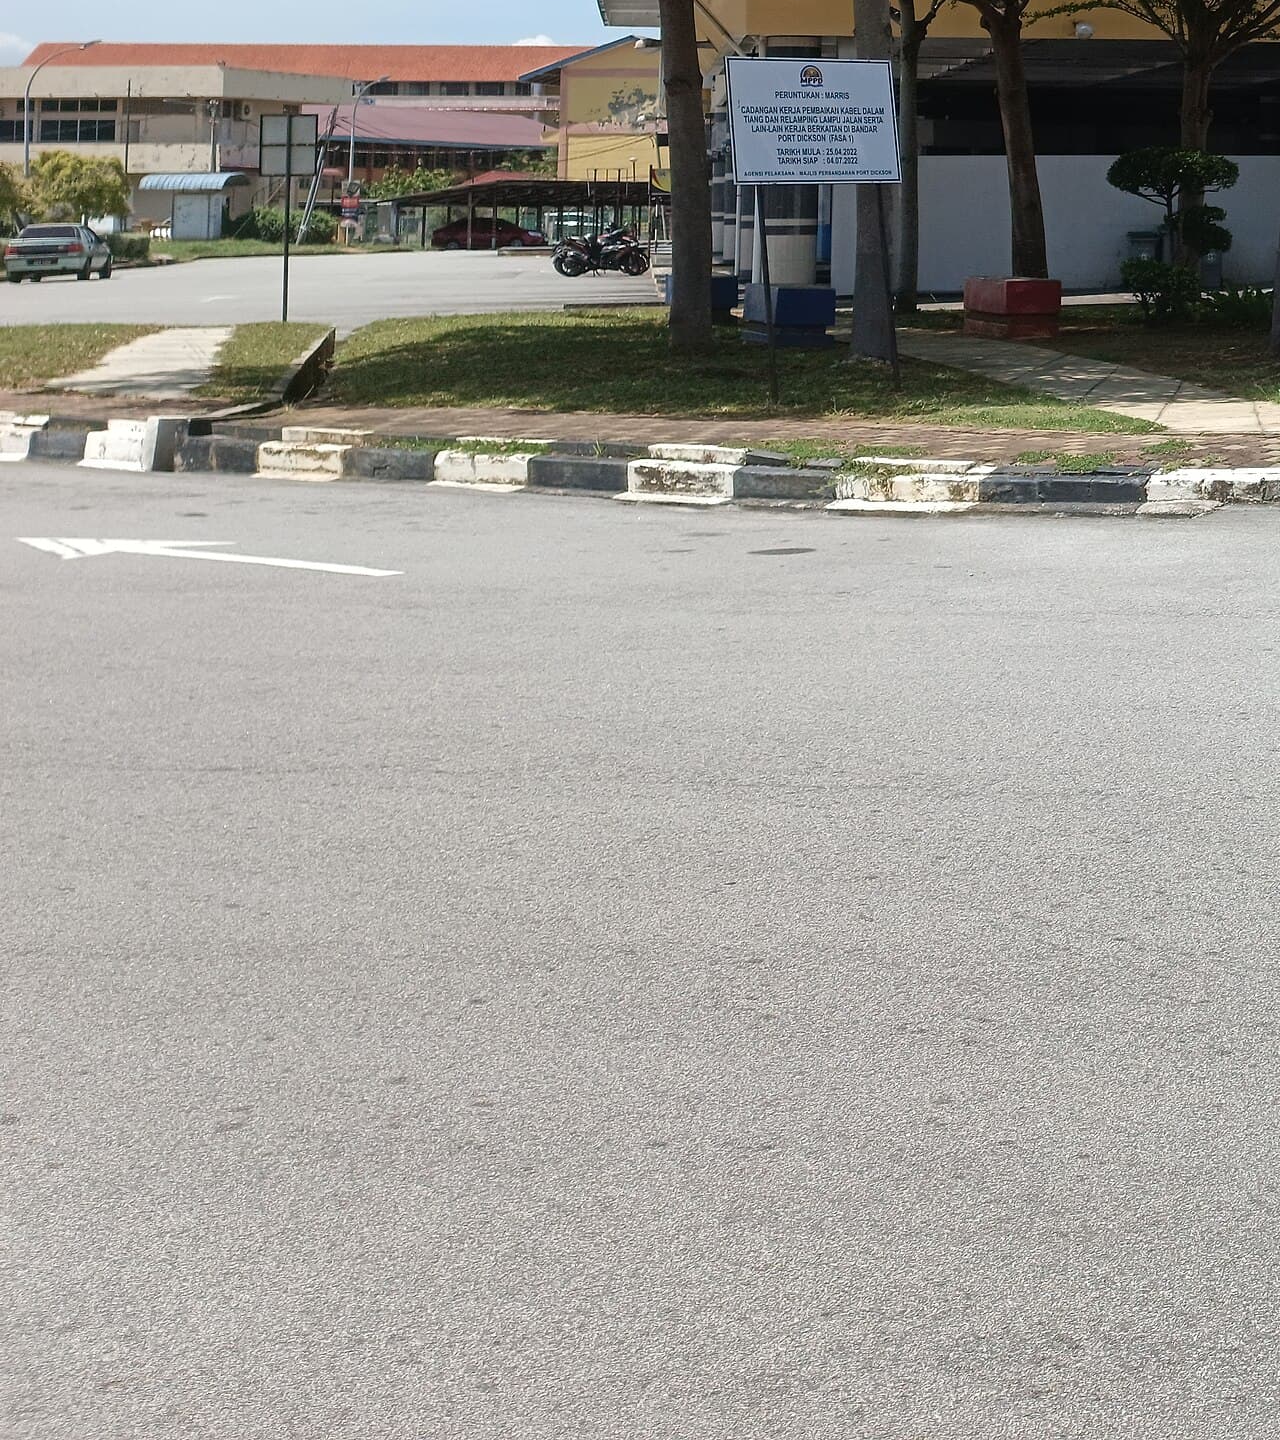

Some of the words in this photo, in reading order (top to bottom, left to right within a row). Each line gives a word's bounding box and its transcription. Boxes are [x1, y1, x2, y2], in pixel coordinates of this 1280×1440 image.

[775, 91, 820, 99] PERUNTUKAN
[824, 92, 850, 100] MARRIS
[741, 106, 778, 114] CADANGAN
[802, 107, 839, 115] PEMBAIKAN
[744, 115, 764, 123] TIANG
[780, 116, 818, 124] RELAMPING
[819, 116, 841, 124] LAMPU
[842, 116, 863, 124] JALAN
[751, 125, 783, 133] LAIN-LAIN
[784, 125, 806, 133] KERJA
[807, 125, 843, 133] BERKAITAN
[778, 134, 796, 142] PORT
[797, 134, 826, 142] DICKSON
[828, 134, 847, 143] (FASA
[776, 148, 801, 156] TARIKH
[802, 148, 821, 156] MULA
[826, 148, 858, 156] 25.04.2022
[777, 157, 801, 165] TARIKH
[802, 157, 818, 165] SIAP
[826, 157, 858, 165] 04.07.2022
